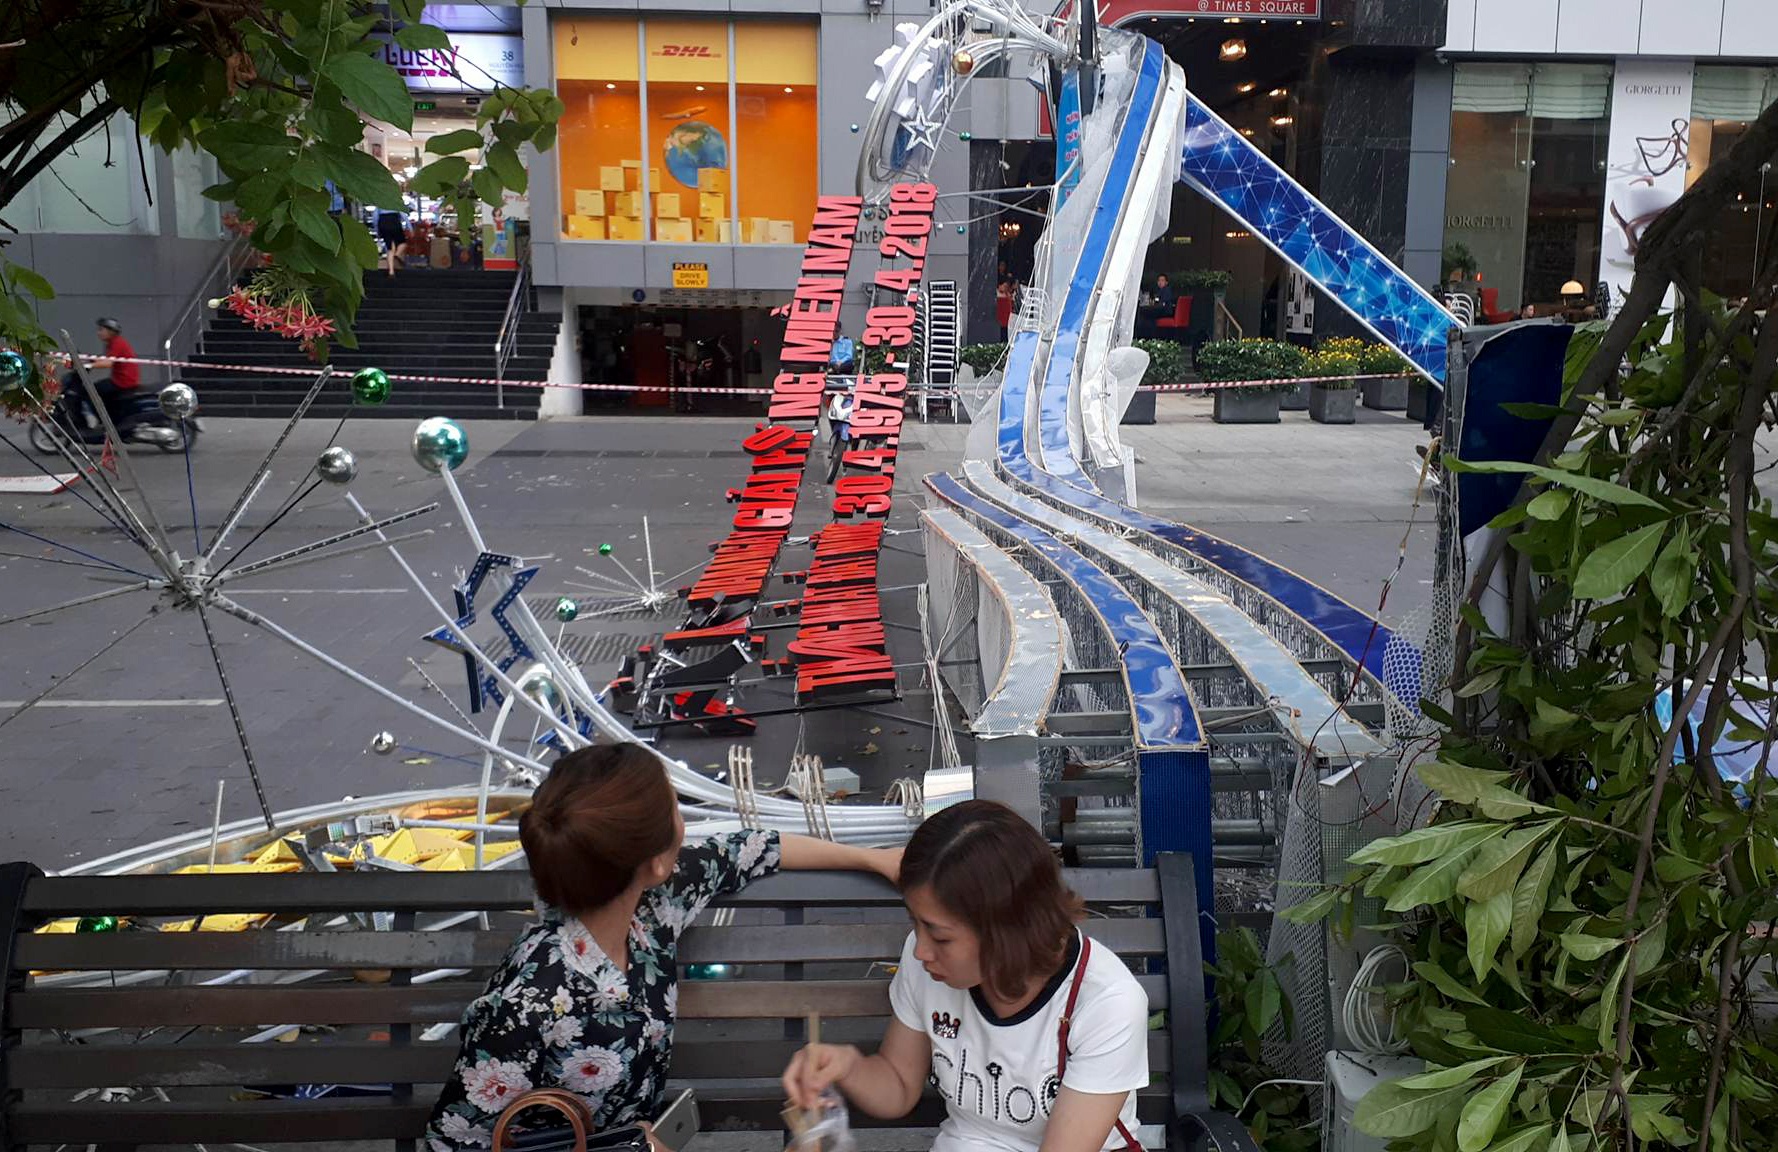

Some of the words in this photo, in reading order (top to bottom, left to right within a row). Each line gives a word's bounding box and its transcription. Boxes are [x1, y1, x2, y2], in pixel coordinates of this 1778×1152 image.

[1197, 0, 1209, 11] @
[1214, 0, 1251, 12] TIMES
[1259, 1, 1306, 13] SQUARE
[501, 50, 514, 61] 38
[661, 45, 711, 58] DHL
[1625, 85, 1682, 95] GIORGETTI
[802, 196, 863, 271] NAM
[675, 263, 706, 271] PLEASE
[862, 182, 938, 346] 30.4.2018
[770, 277, 846, 361] MIỀN
[832, 373, 908, 517] 30.4.1975
